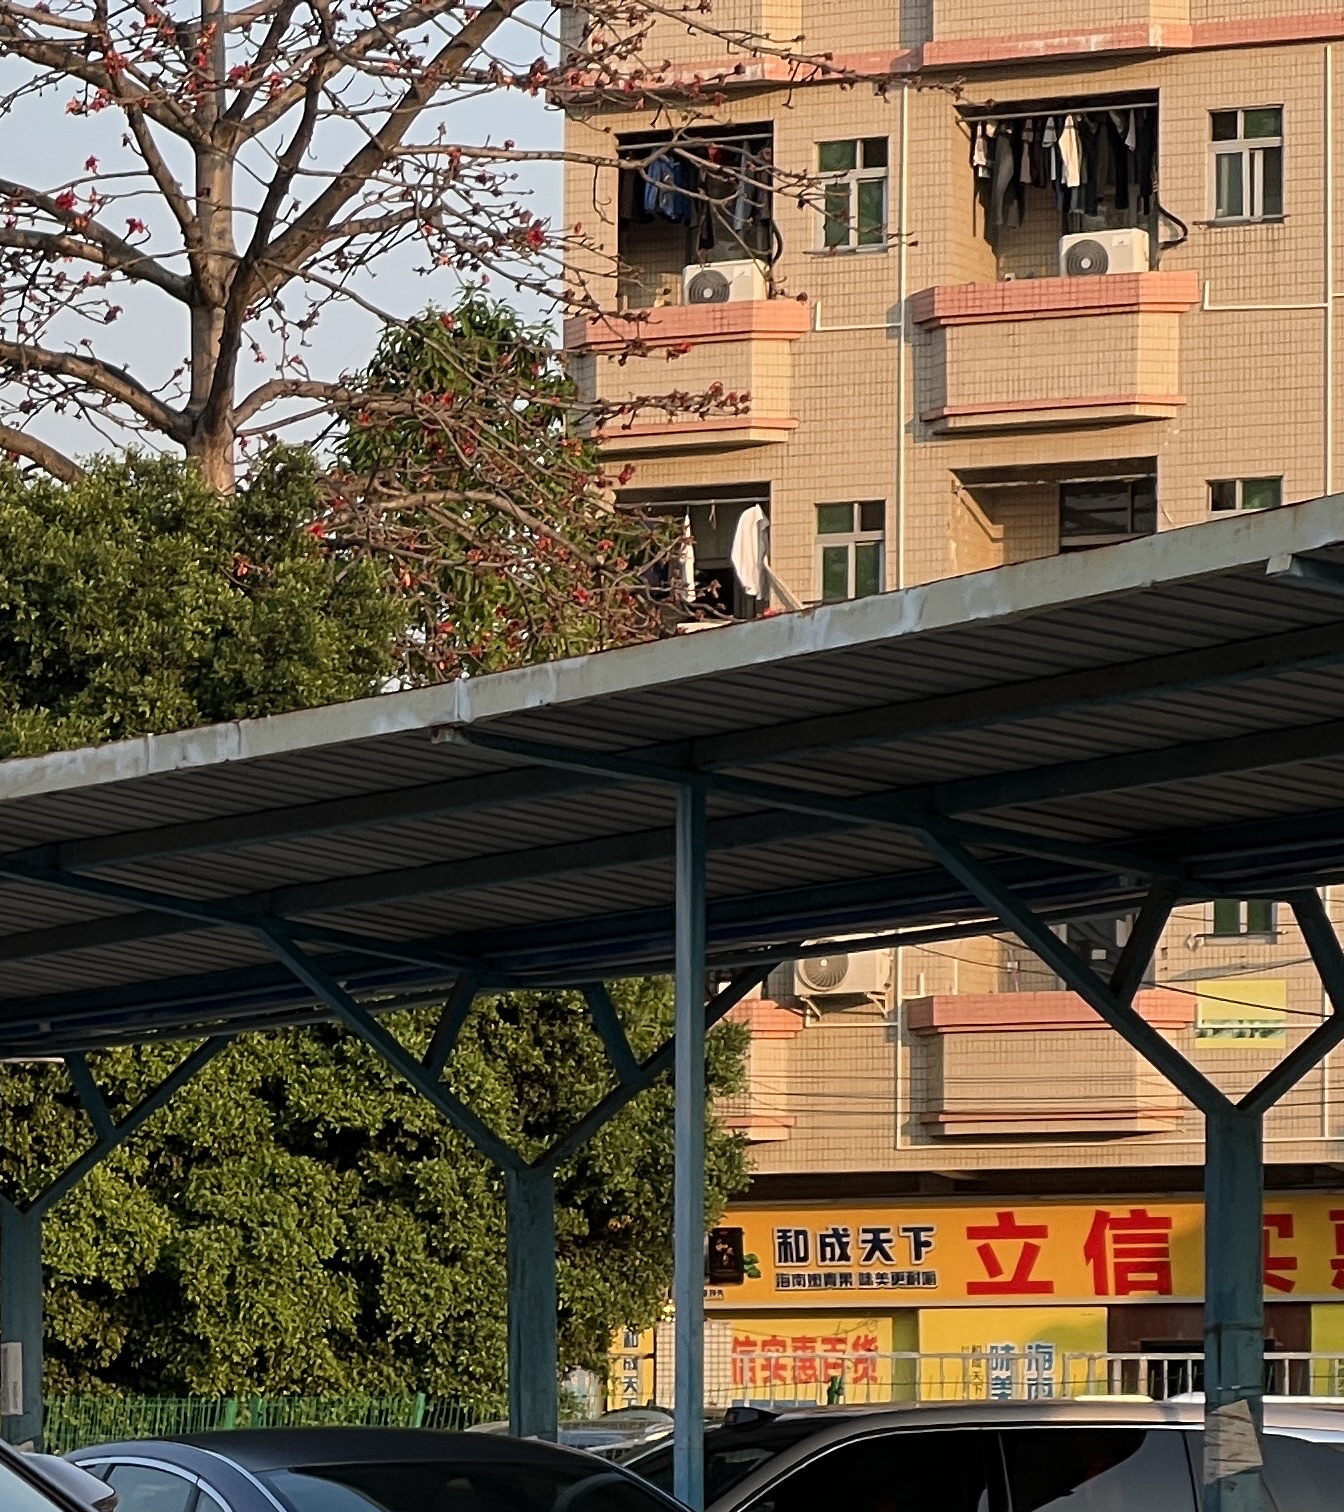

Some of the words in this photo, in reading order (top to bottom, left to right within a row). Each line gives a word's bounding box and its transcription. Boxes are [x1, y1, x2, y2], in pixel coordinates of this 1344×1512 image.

[774, 1226, 936, 1265] 和成天下
[967, 1209, 1344, 1296] 立信
